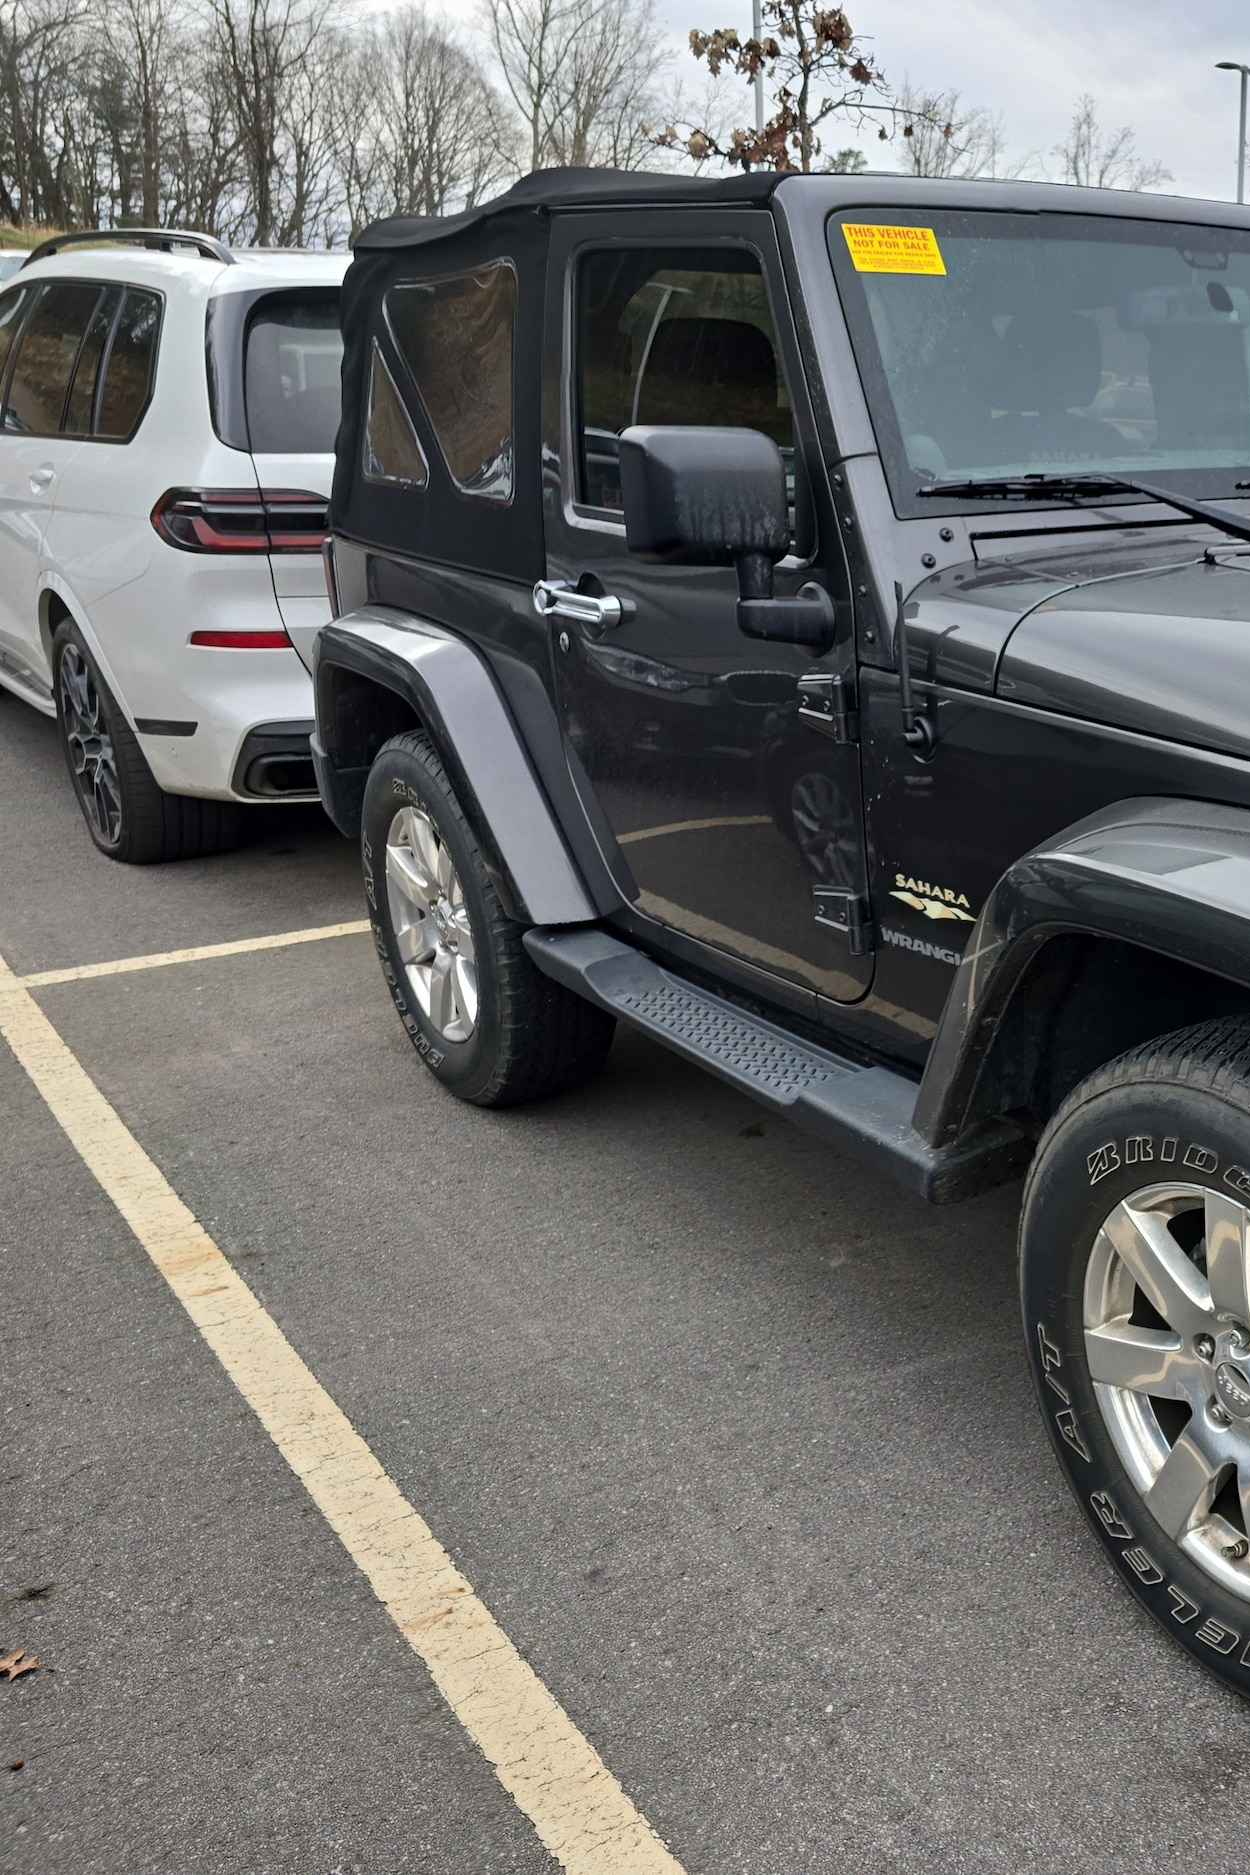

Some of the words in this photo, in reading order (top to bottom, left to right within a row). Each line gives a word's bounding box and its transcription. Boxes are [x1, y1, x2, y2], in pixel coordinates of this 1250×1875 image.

[846, 226, 875, 238] THIS
[878, 228, 929, 241] VEHICLE
[852, 239, 875, 248] NOT
[878, 240, 901, 249] FOR
[902, 242, 930, 251] SALE
[895, 873, 970, 908] SAHARA
[1036, 1321, 1093, 1464] A/T
